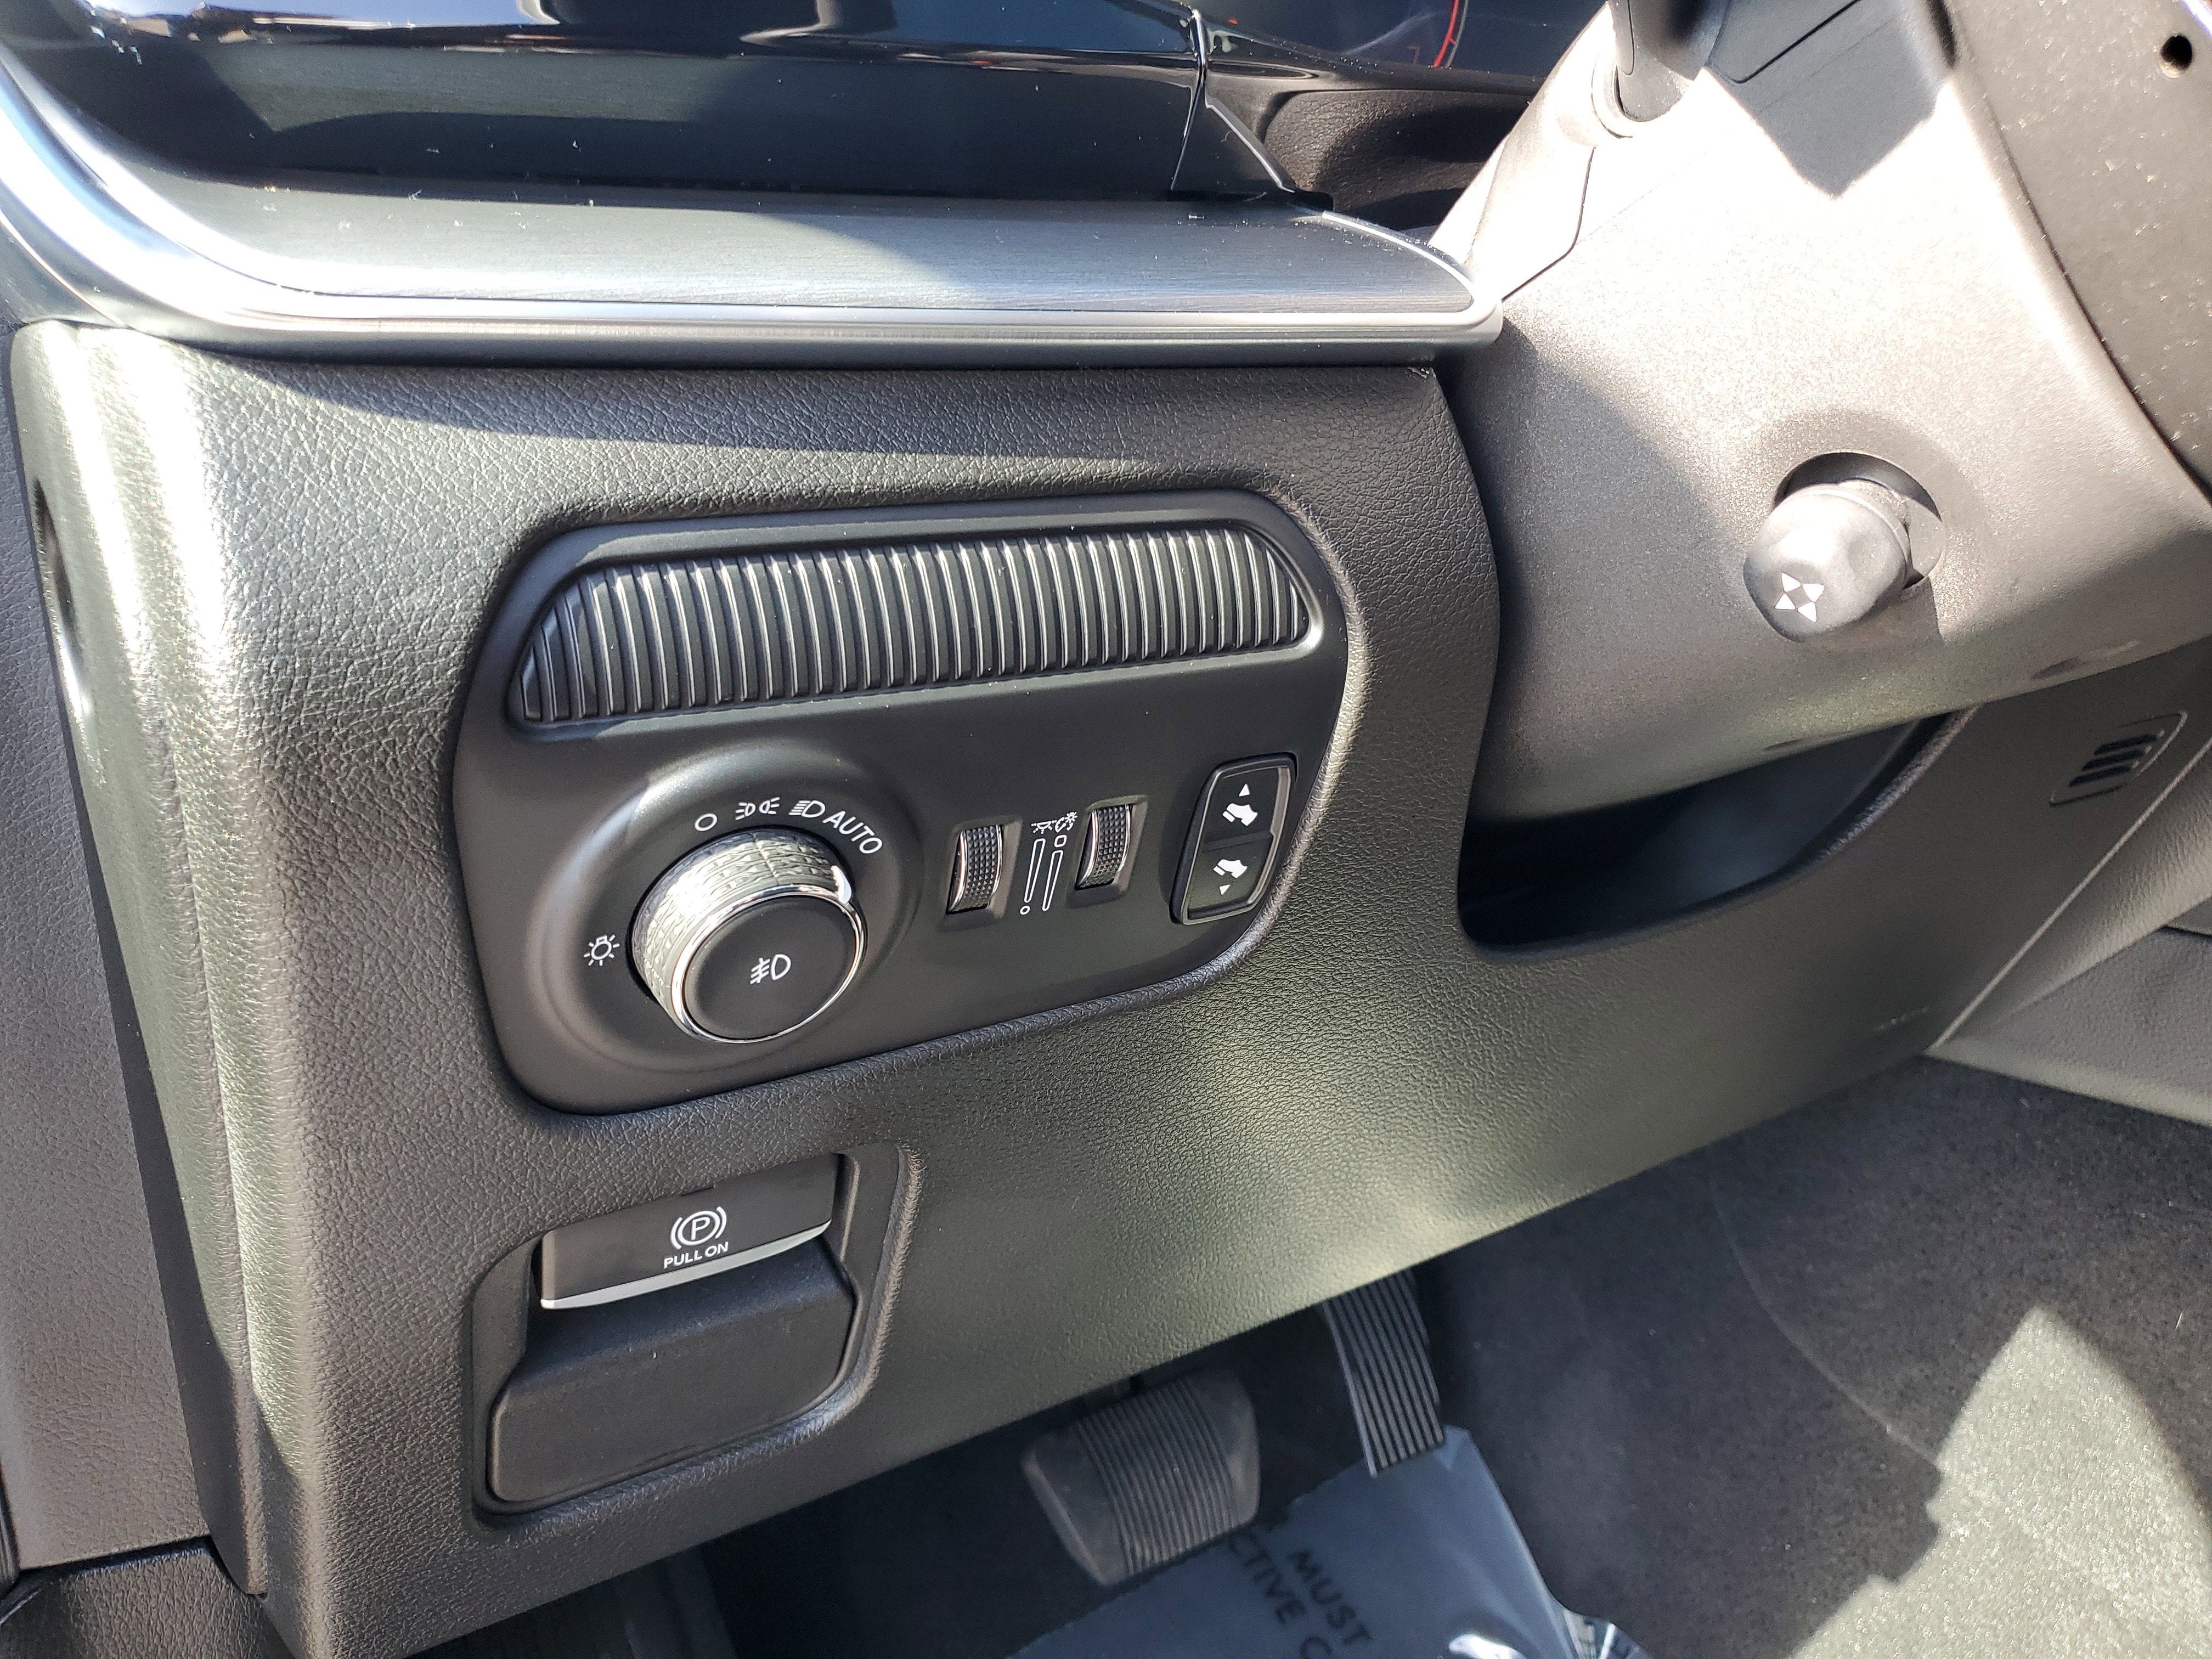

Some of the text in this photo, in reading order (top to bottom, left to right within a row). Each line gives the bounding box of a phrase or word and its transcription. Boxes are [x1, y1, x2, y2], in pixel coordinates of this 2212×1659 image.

[823, 810, 883, 854] AUTO
[691, 1216, 710, 1240] P
[663, 1241, 729, 1269] PULL ON
[1287, 1549, 1374, 1645] MUST
